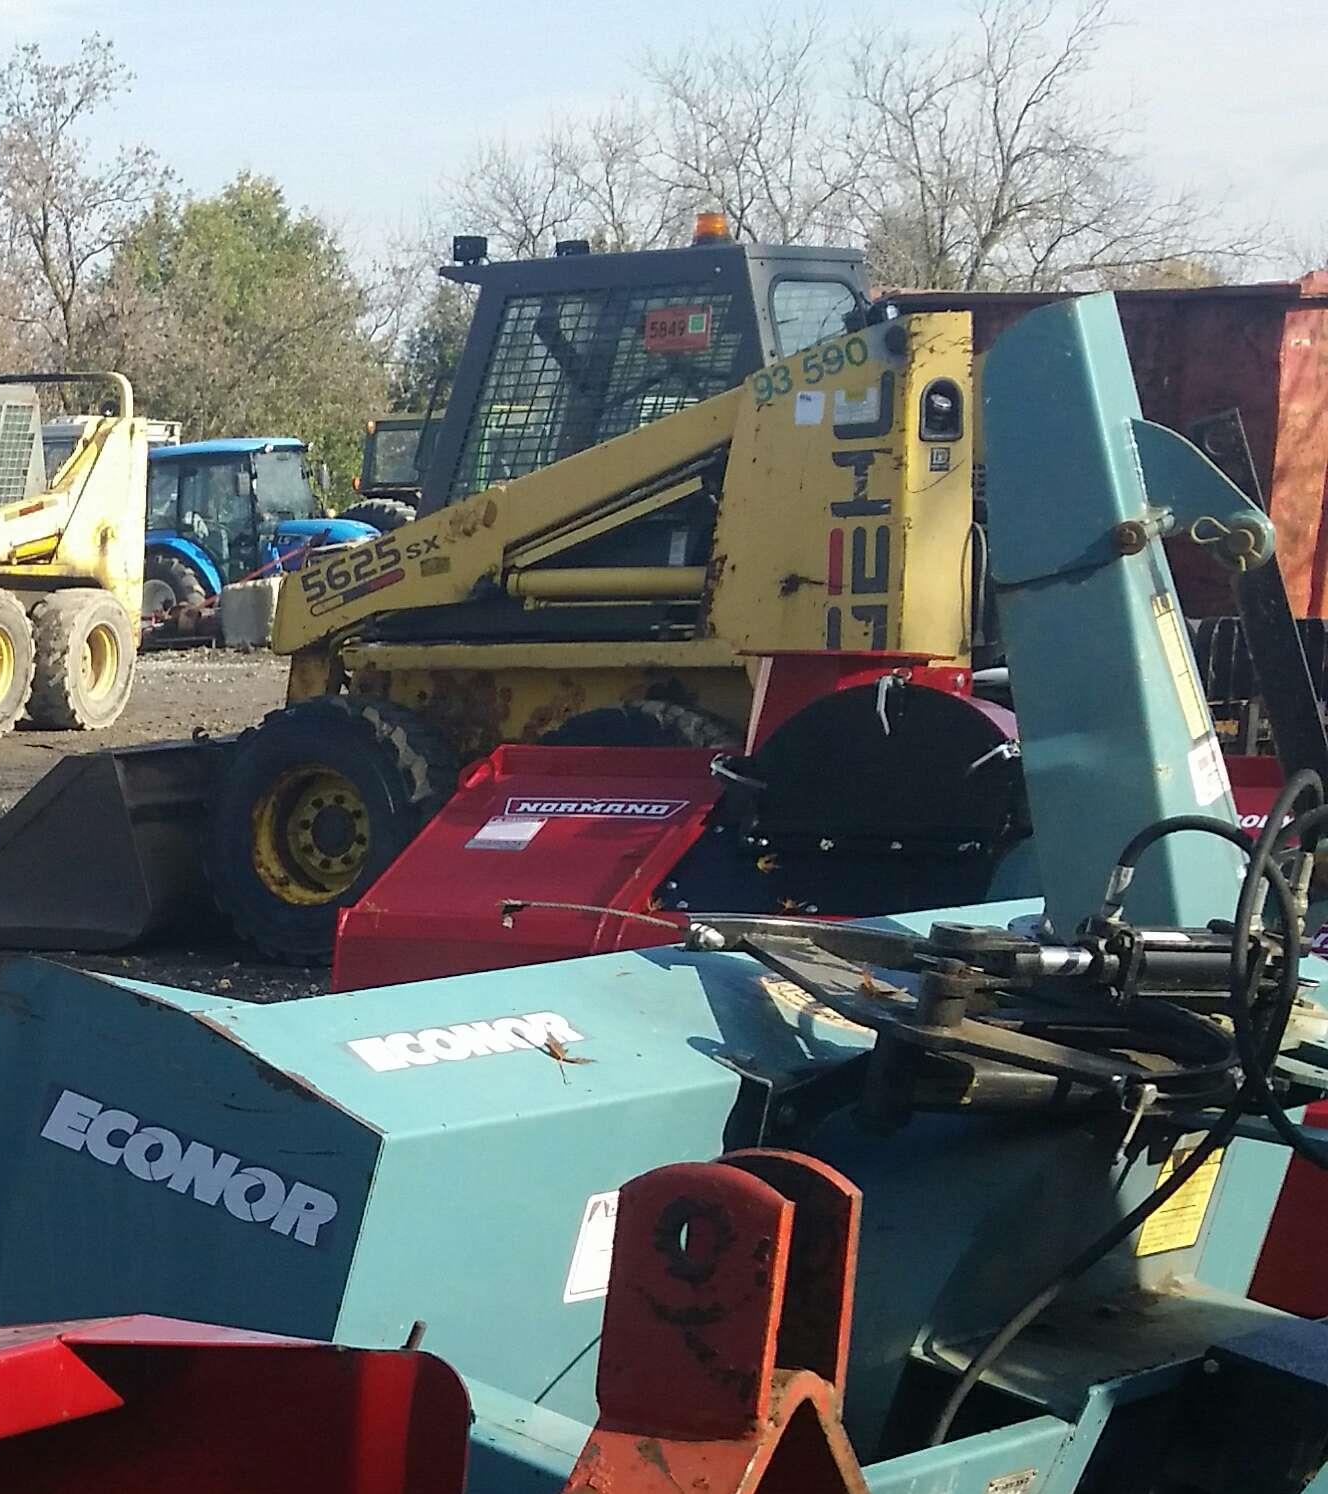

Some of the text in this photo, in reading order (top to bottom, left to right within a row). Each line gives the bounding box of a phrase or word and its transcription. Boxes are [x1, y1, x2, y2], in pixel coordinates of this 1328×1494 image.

[752, 336, 868, 403] 93 590
[301, 536, 401, 603] 5625
[515, 802, 669, 815] NORMAND
[40, 1089, 339, 1247] ECONOR
